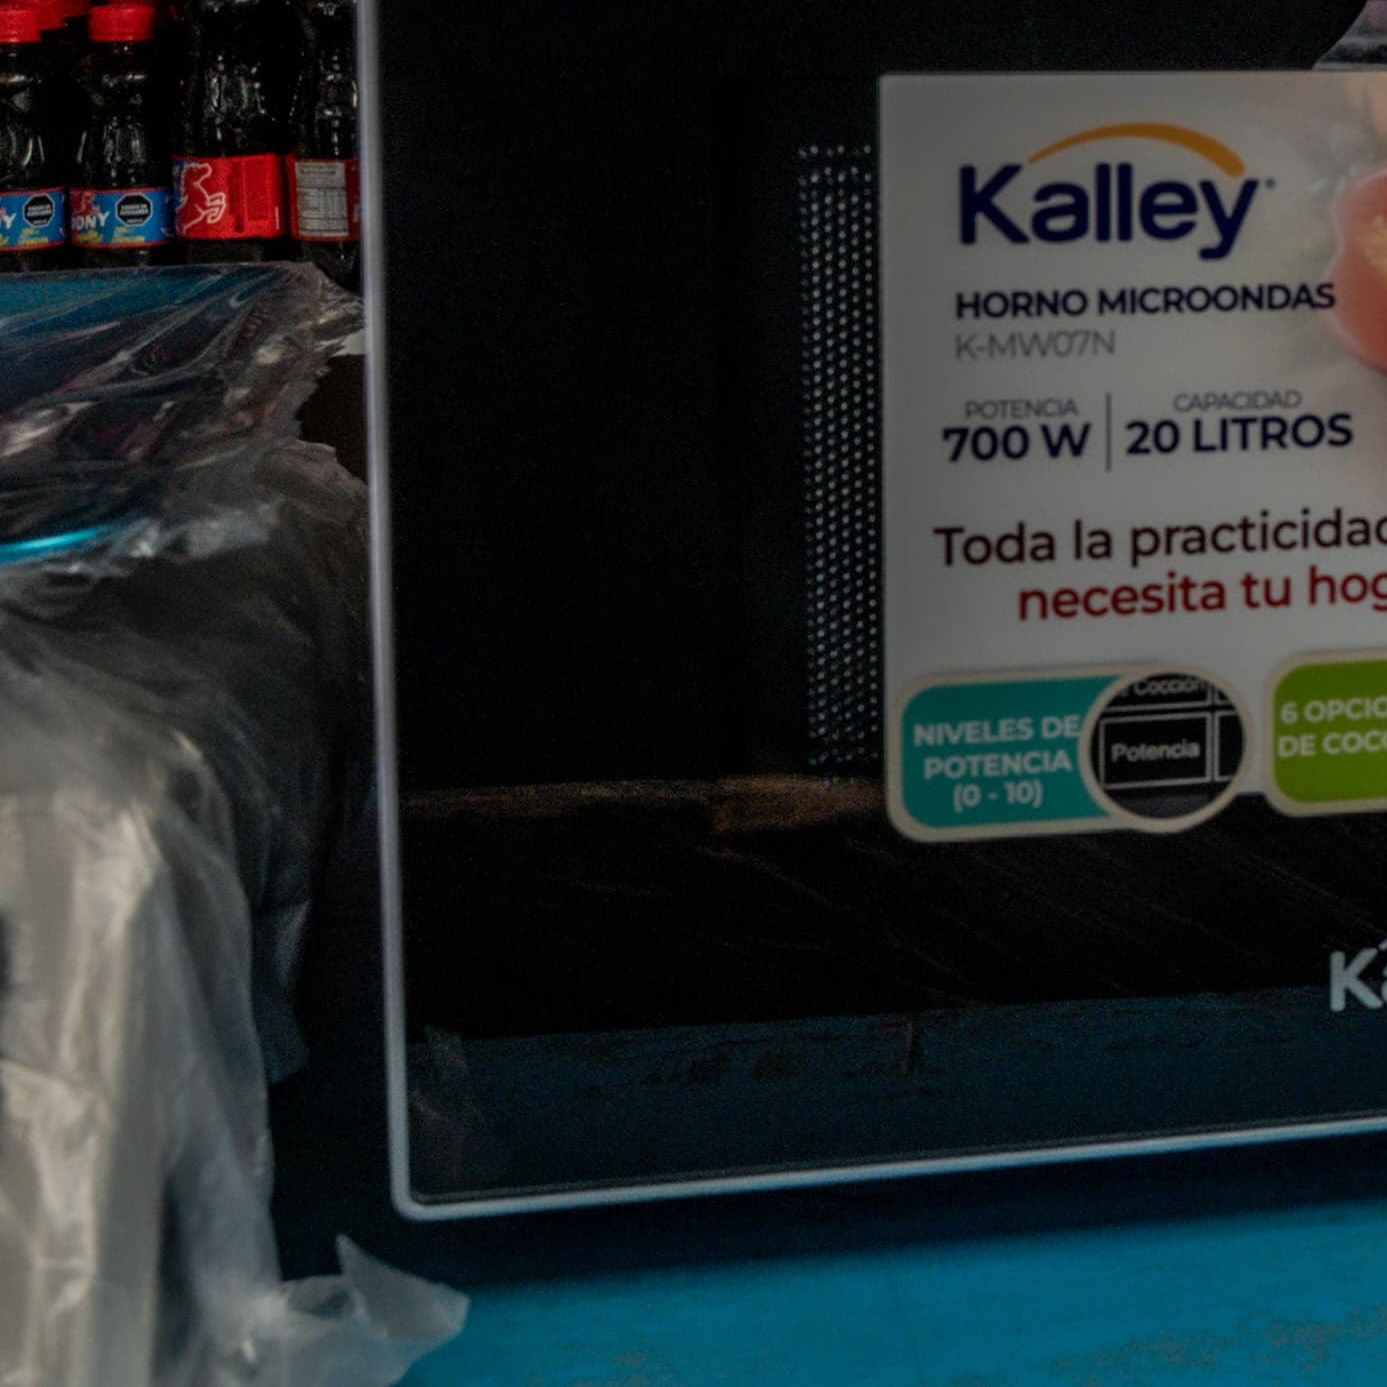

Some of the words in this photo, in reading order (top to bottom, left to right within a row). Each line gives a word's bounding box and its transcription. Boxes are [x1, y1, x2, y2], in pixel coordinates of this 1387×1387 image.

[958, 162, 1260, 261] Kalley
[955, 287, 1088, 320] HORNO
[1100, 281, 1337, 316] MICROONDAS
[955, 329, 1116, 361] K-MW07N
[965, 398, 1079, 421] POTENCIA
[1173, 389, 1303, 414] CAPACIDAD
[942, 425, 1031, 463] 700
[1039, 422, 1092, 459] W
[1126, 419, 1181, 456] 20
[1193, 413, 1354, 453] LITROS
[934, 522, 1057, 568] Toda
[1073, 517, 1113, 561] la
[1018, 571, 1226, 621] necesita
[1241, 572, 1292, 609] tu
[1280, 700, 1302, 725] 6
[913, 714, 1034, 748] NIVELES
[1041, 713, 1081, 740] DE
[1277, 732, 1317, 758] DE
[923, 748, 1073, 780] POTENCIA
[1111, 737, 1201, 763] Potencia
